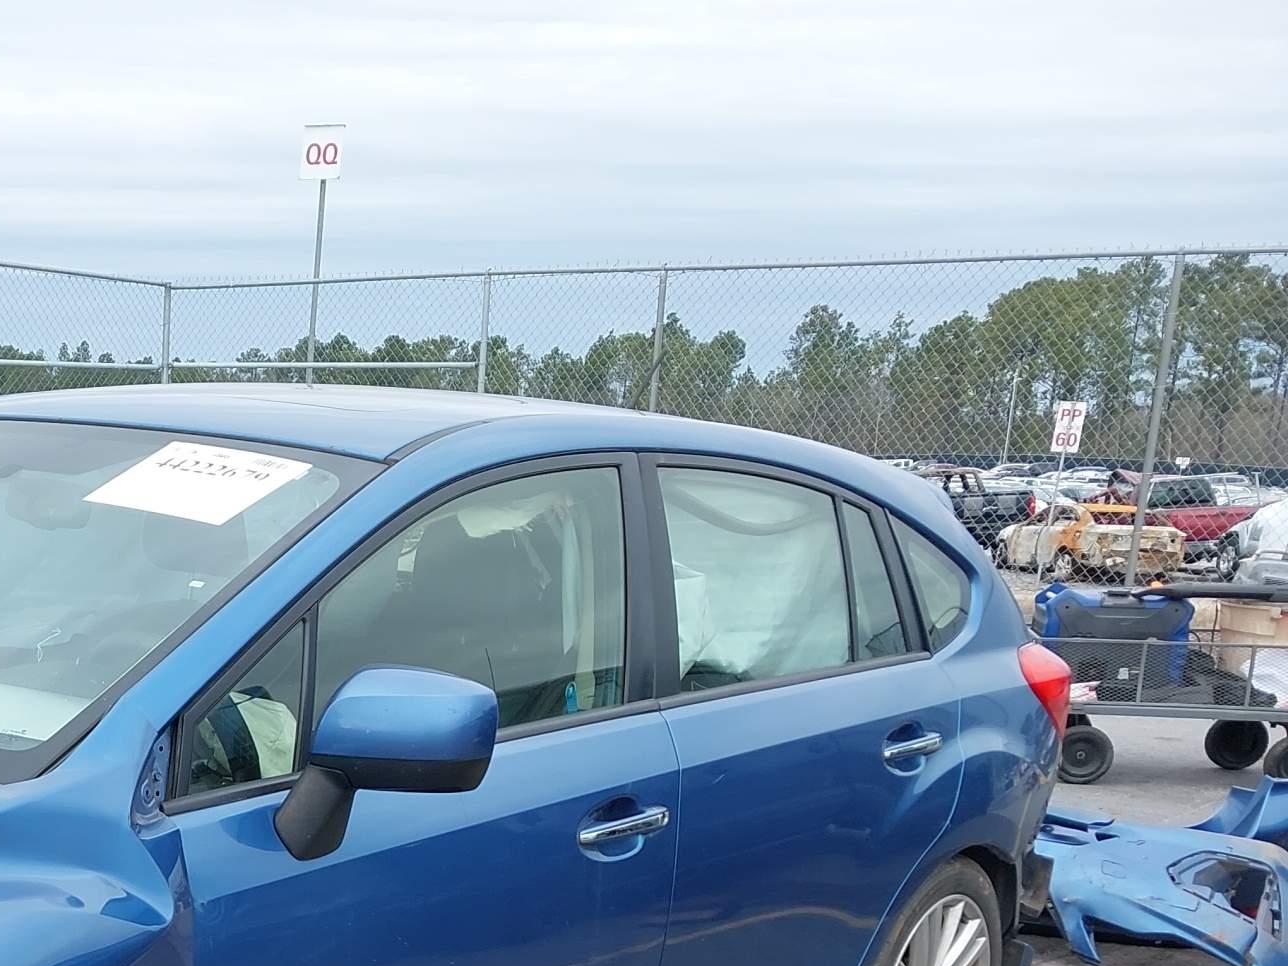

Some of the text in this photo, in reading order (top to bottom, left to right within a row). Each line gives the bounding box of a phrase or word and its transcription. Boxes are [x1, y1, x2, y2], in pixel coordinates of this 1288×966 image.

[306, 143, 338, 165] QQ
[1061, 408, 1083, 422] PP
[1055, 432, 1078, 447] 60
